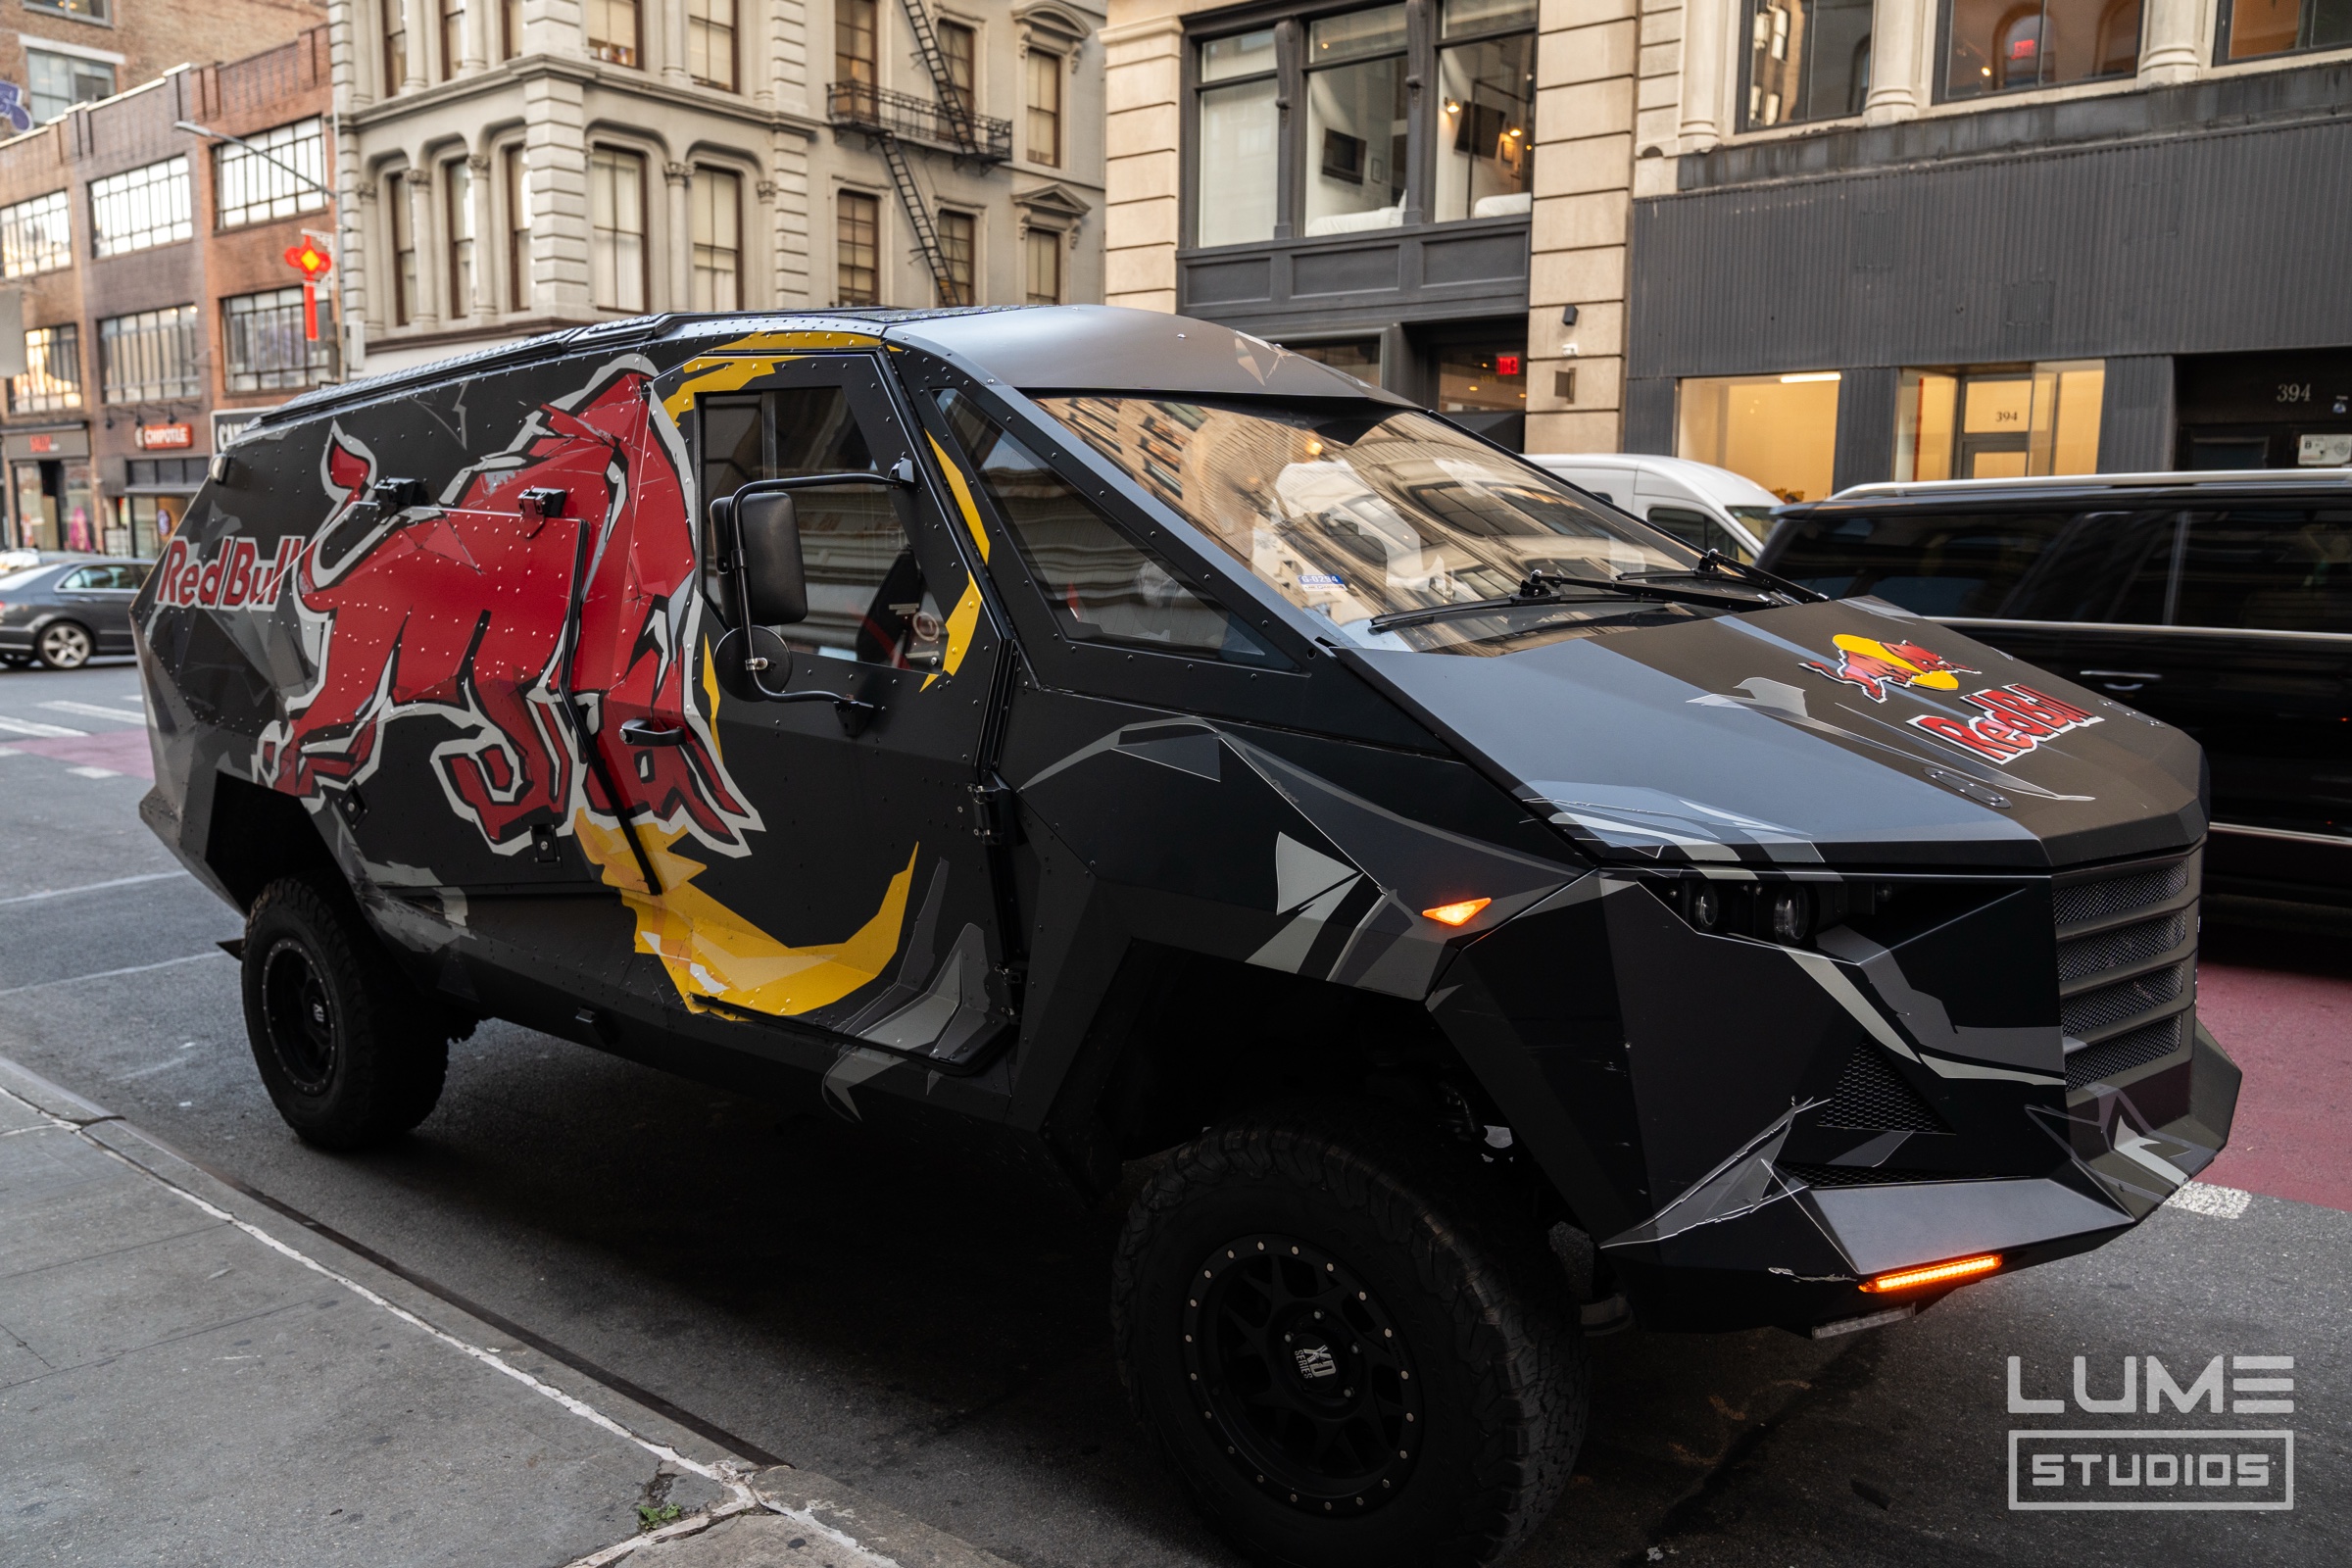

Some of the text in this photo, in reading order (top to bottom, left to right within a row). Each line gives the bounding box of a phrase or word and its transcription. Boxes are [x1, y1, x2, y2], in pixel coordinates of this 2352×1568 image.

[2276, 383, 2311, 402] 394
[1995, 411, 2018, 422] 394
[145, 427, 188, 445] CHIPOTLE
[1295, 1349, 1313, 1379] SERIES
[1303, 1345, 1337, 1378] XD
